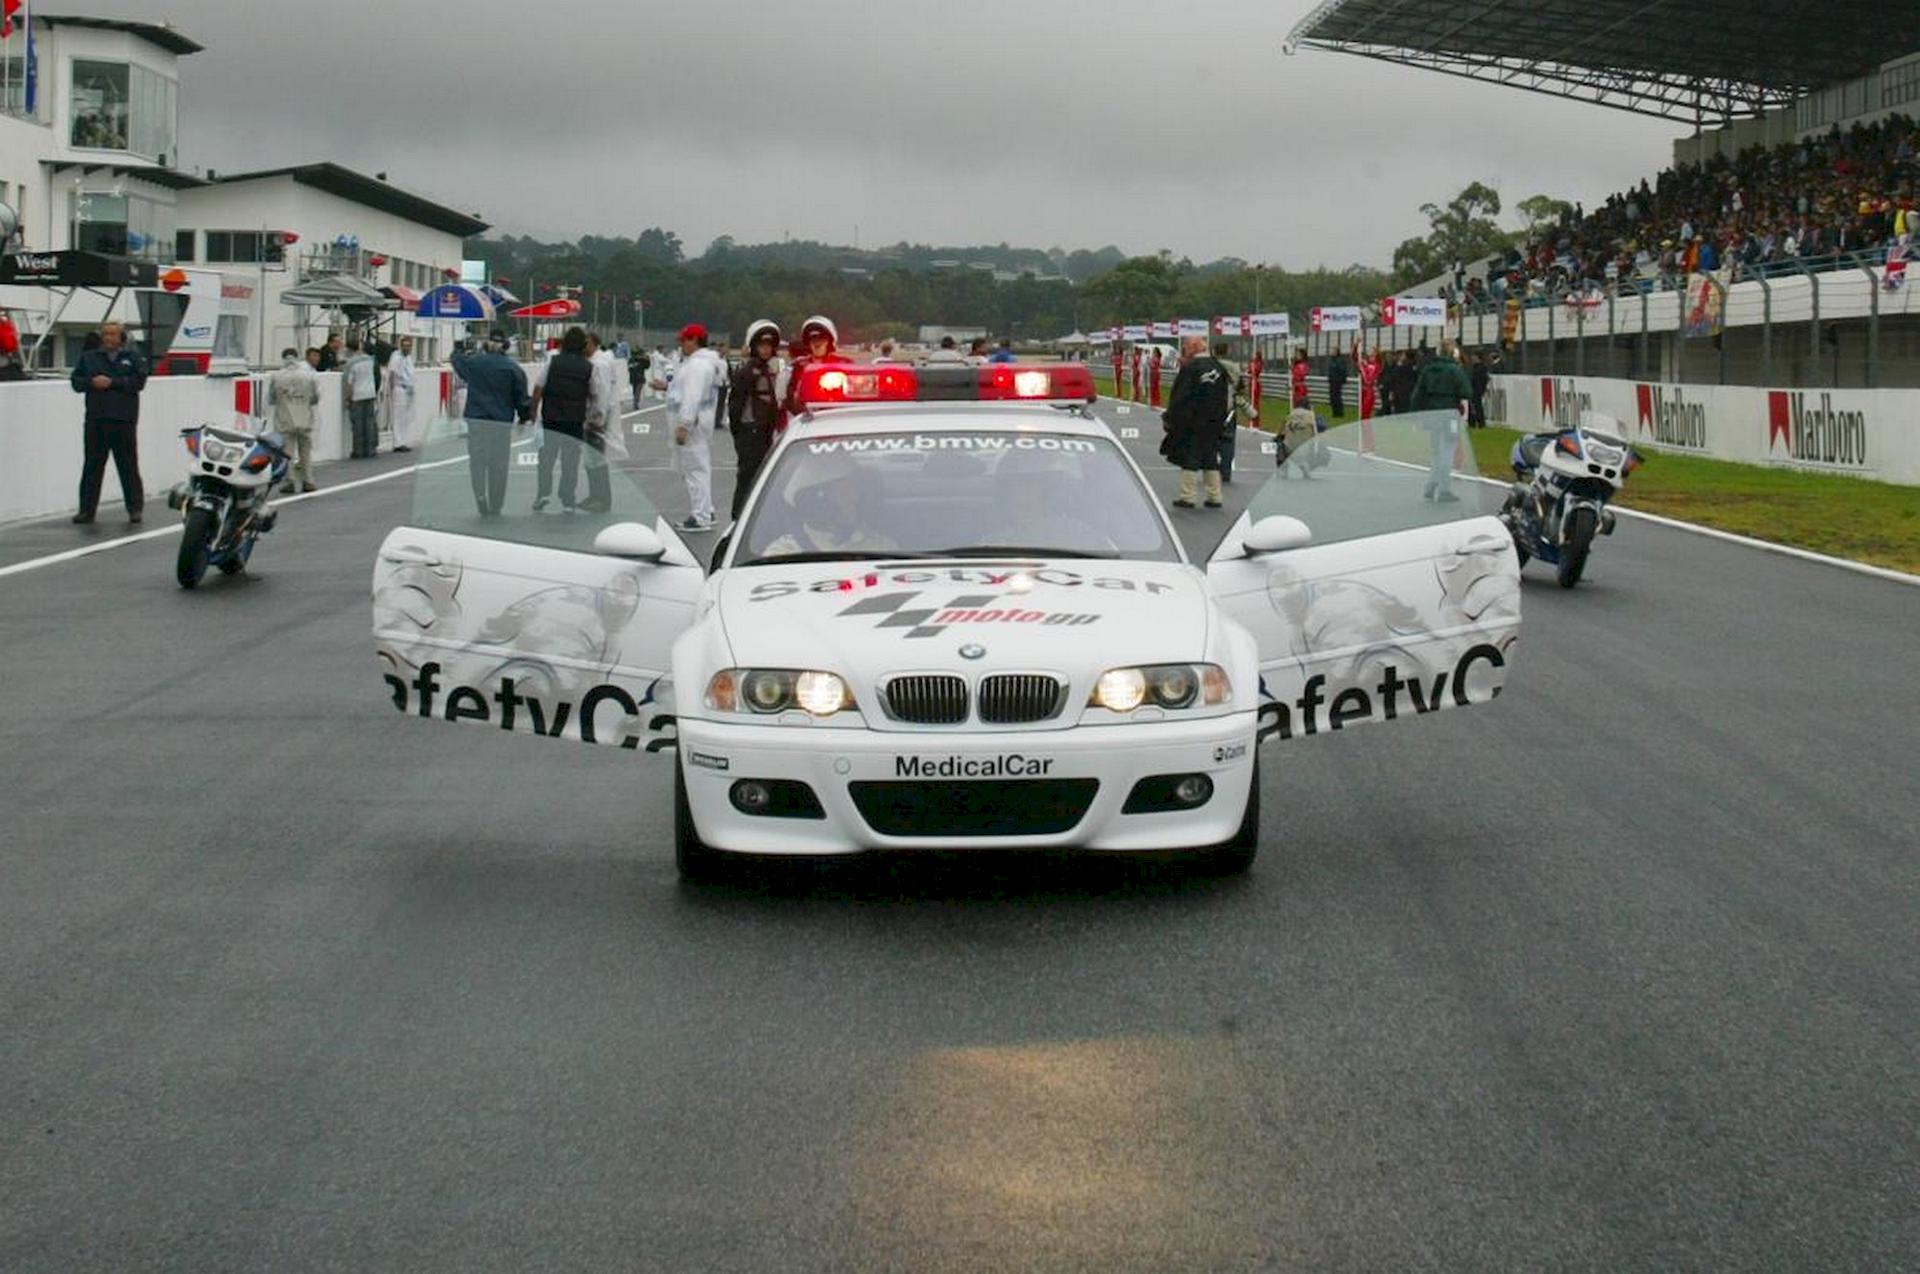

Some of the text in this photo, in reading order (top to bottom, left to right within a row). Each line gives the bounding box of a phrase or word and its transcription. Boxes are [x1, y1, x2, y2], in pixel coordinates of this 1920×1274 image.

[15, 254, 60, 269] West
[1384, 306, 1393, 317] 1
[1652, 385, 1706, 448] Marlboro
[1790, 392, 1866, 465] Marlboro
[808, 434, 1096, 454] www.bmw.com
[895, 754, 1054, 777] MedicalCar
